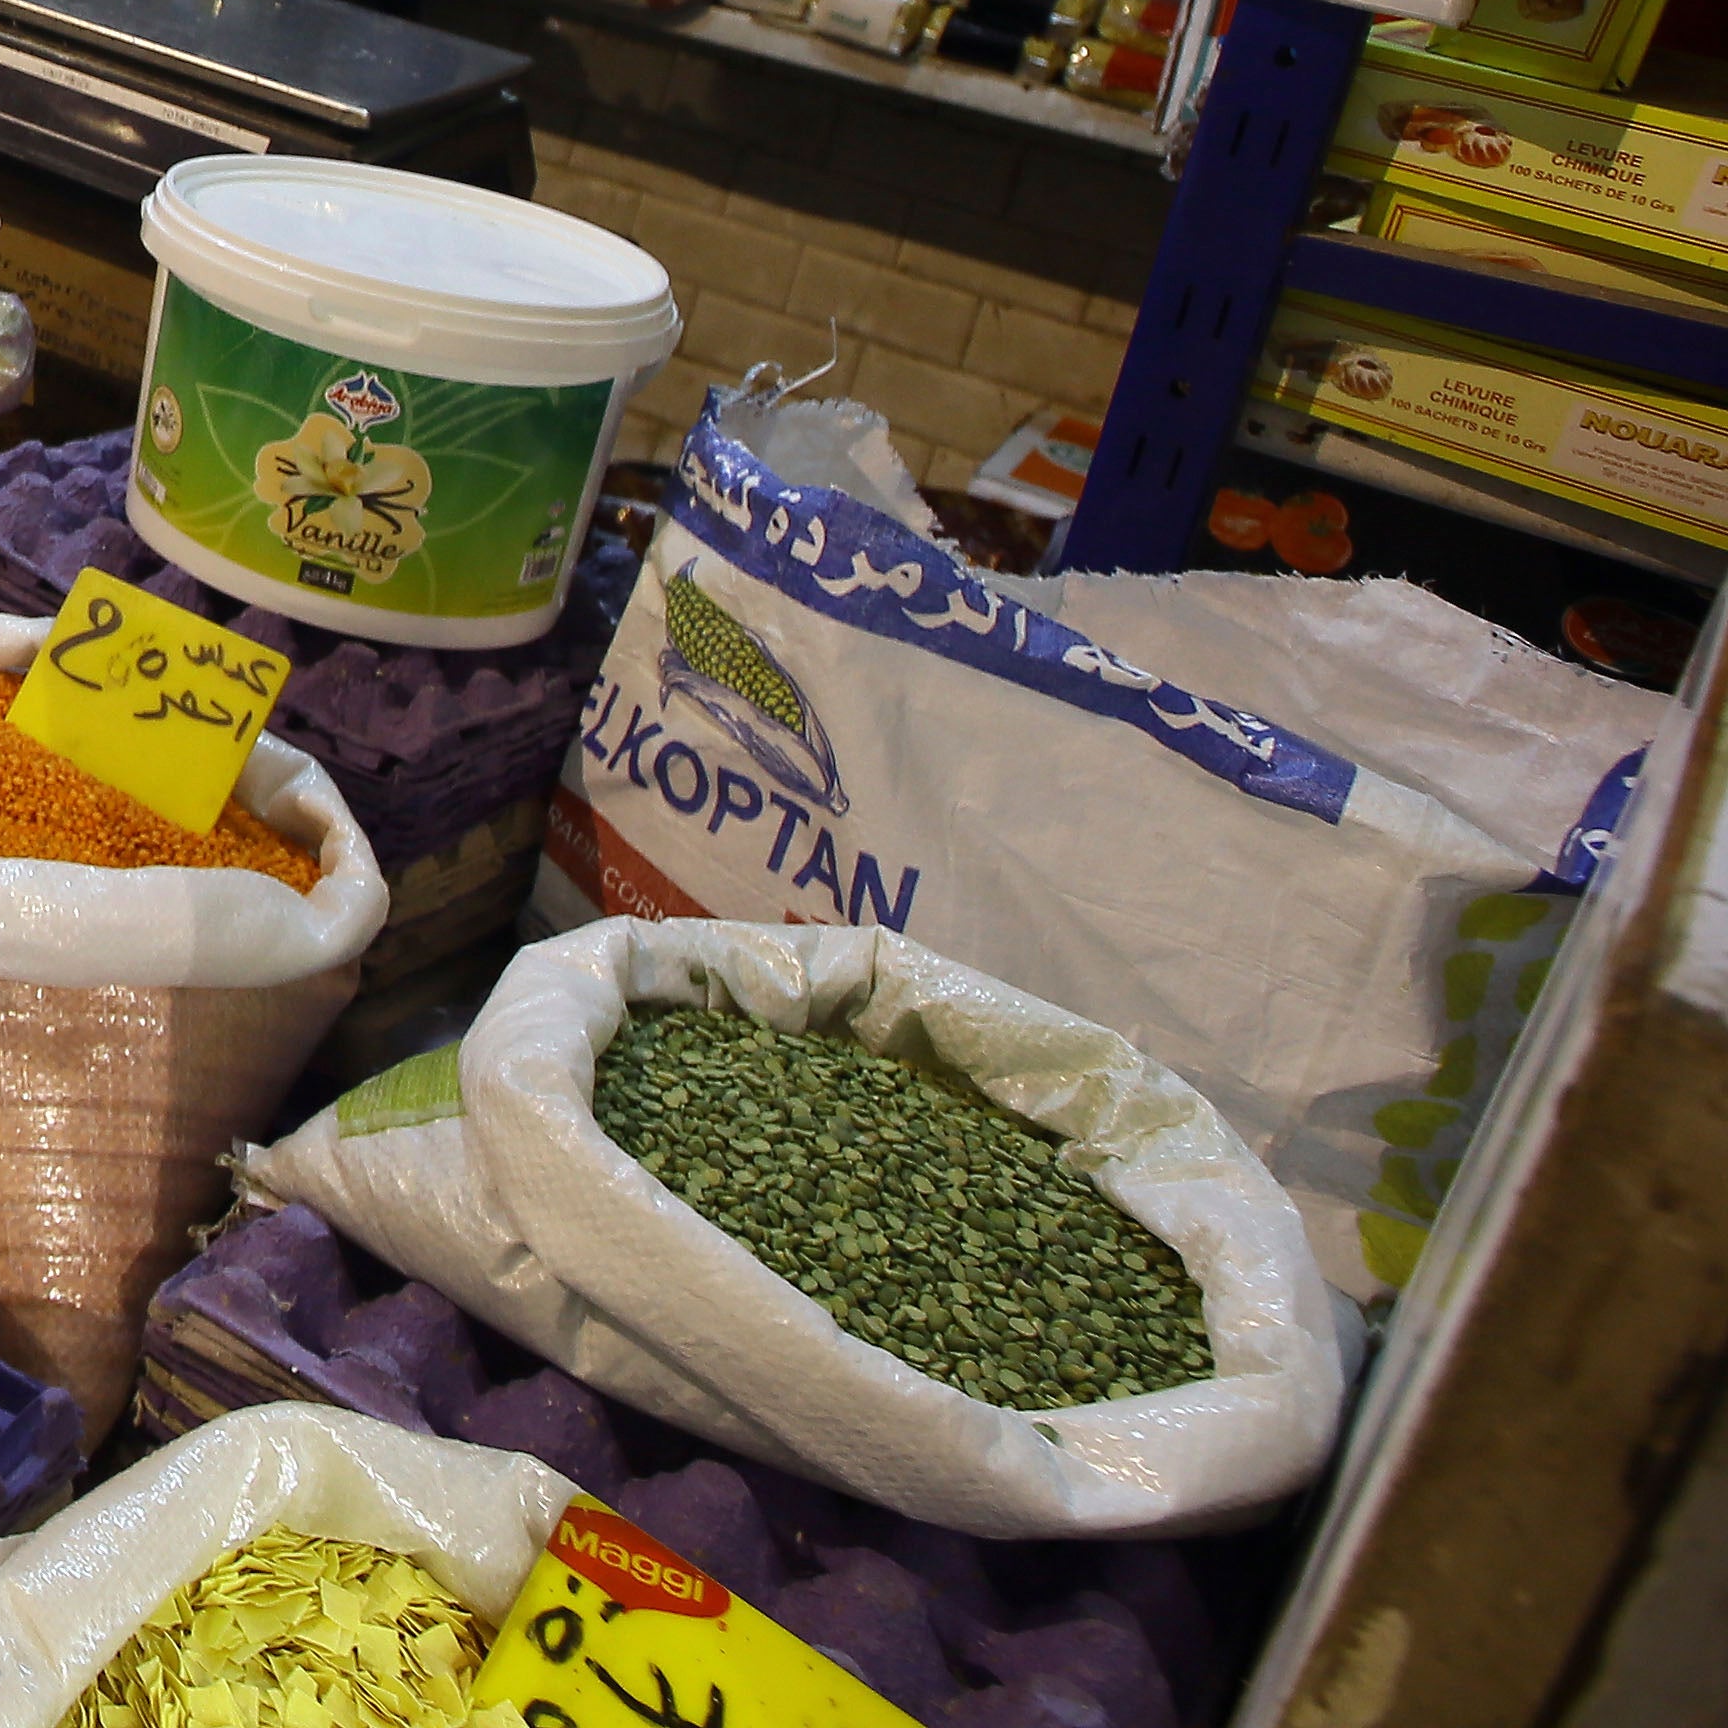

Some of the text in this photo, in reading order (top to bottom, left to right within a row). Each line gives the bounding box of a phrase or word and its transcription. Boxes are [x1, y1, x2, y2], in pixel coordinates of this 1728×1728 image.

[1551, 153, 1647, 187] CHIMIQUE
[1566, 139, 1644, 168] LEVURE
[1509, 163, 1676, 214] 100 SACHETS DE 10 Grs
[1429, 390, 1519, 427] CHIMIQUE
[1443, 377, 1516, 410] LEVURE
[1390, 397, 1412, 412] 100
[1414, 403, 1479, 432] SACHETS
[1480, 423, 1501, 440] DE
[1504, 432, 1521, 446] 10
[283, 497, 402, 561] Vanille
[558, 1519, 706, 1605] Maggi
